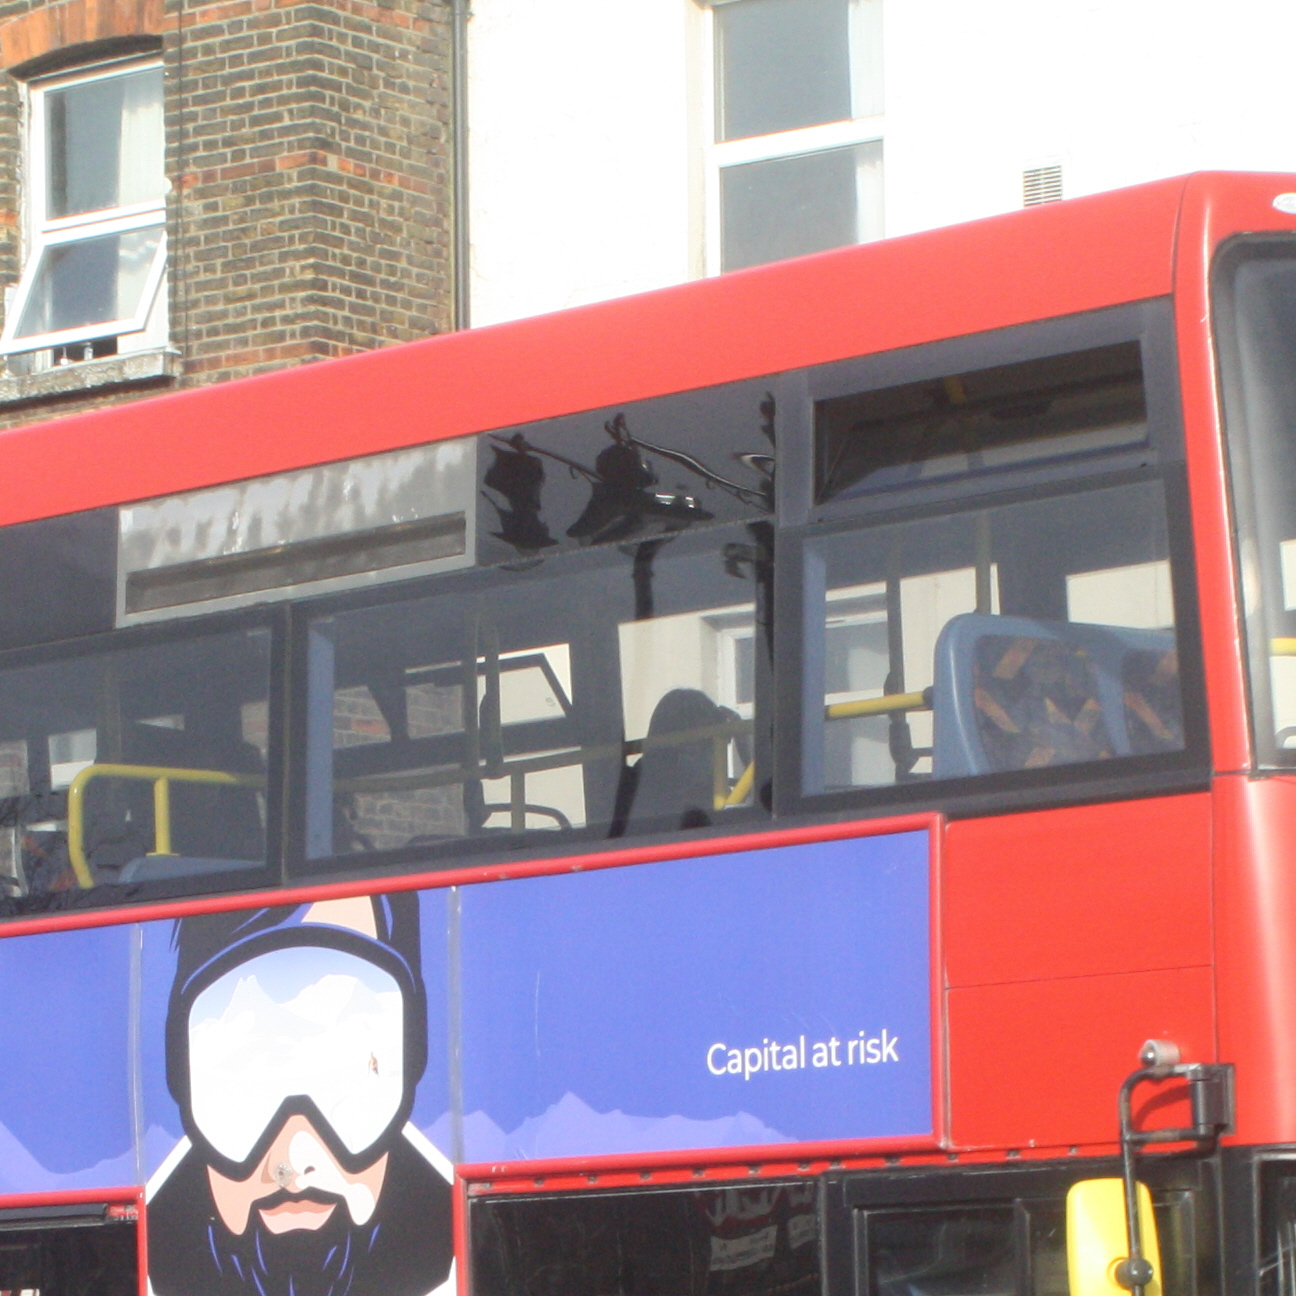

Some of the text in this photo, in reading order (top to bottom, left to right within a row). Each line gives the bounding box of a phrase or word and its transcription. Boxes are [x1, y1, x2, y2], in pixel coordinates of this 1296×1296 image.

[706, 1028, 899, 1081] Capital at risk
